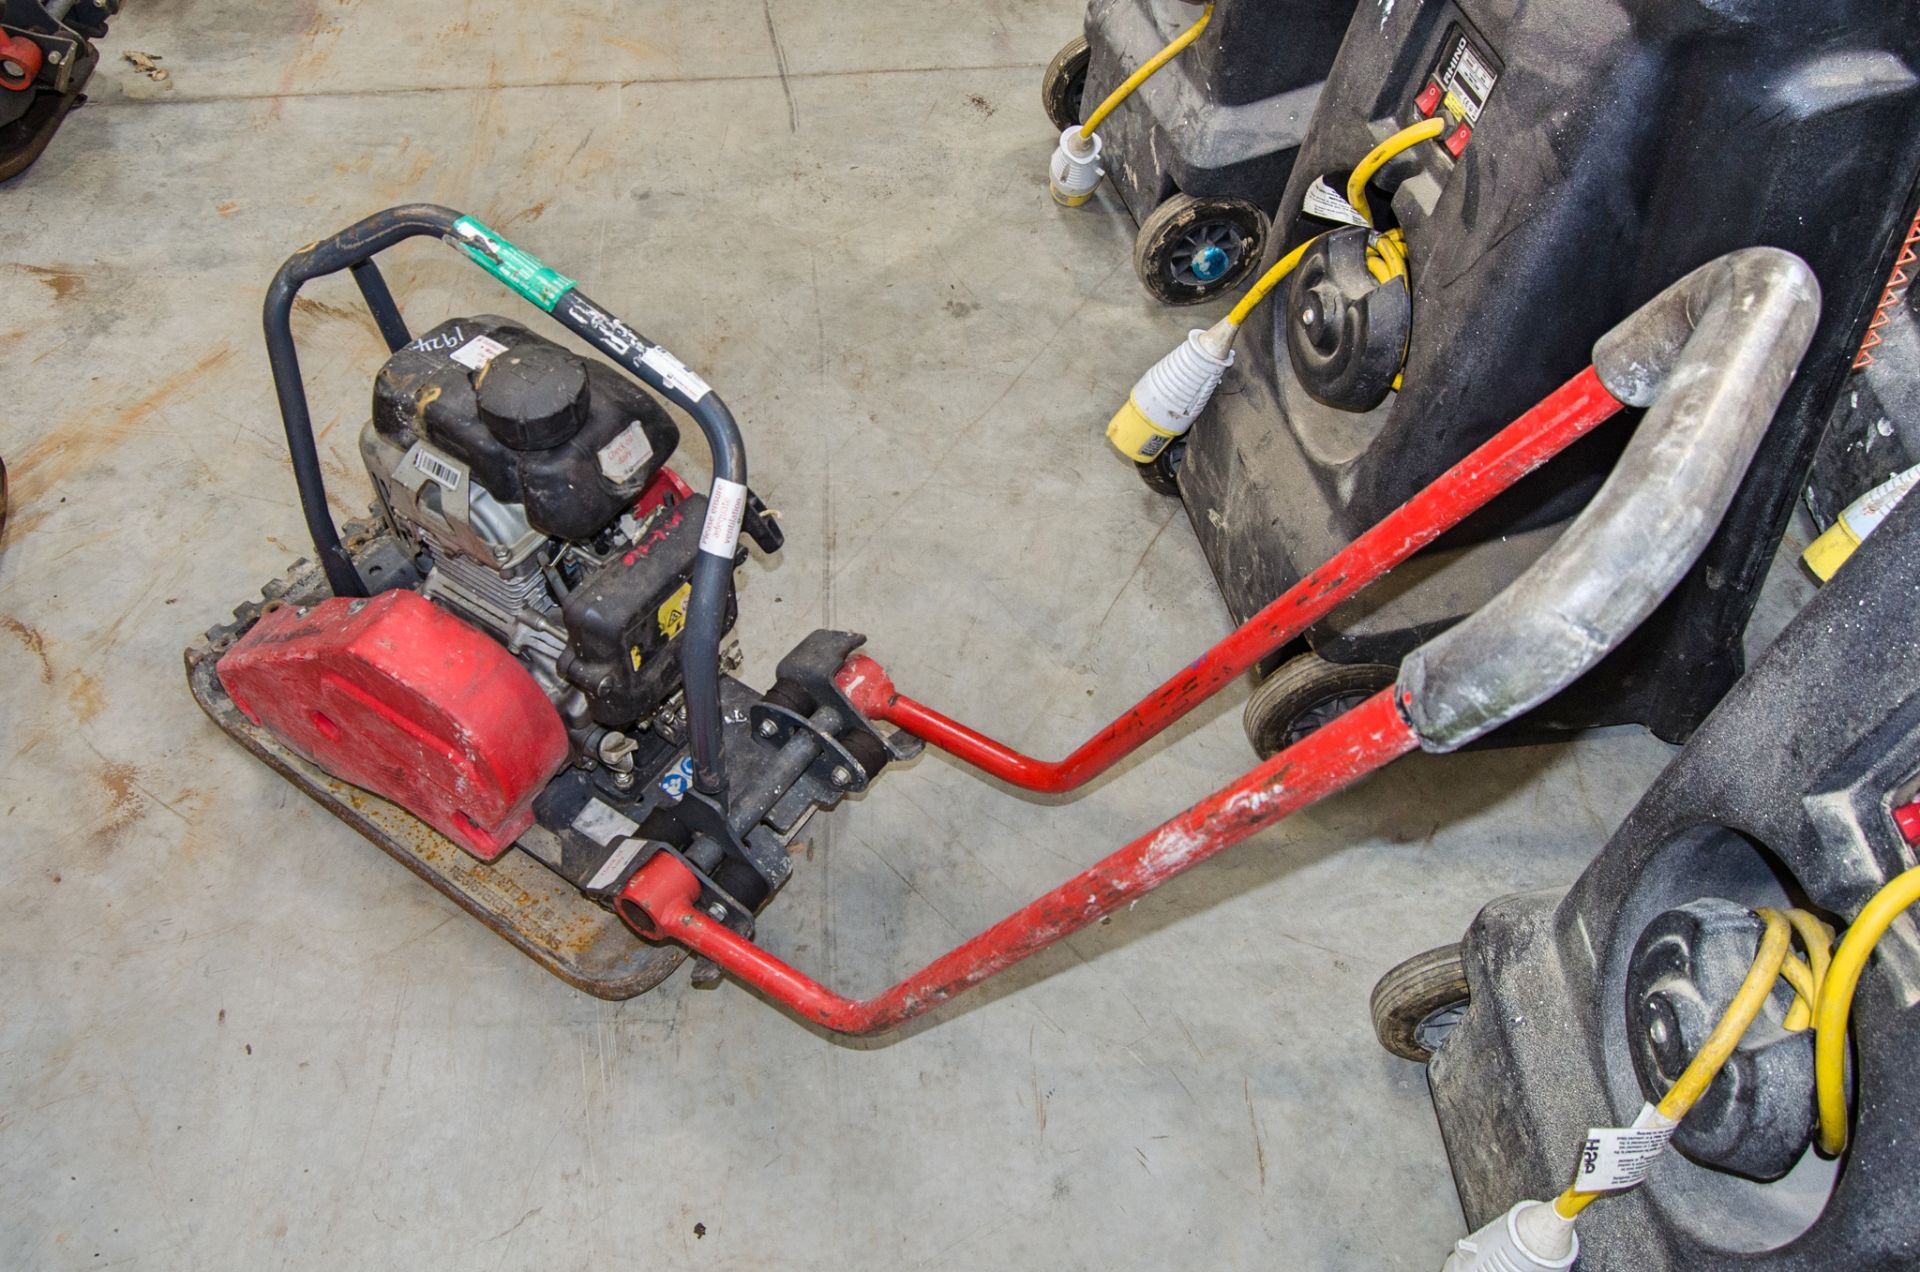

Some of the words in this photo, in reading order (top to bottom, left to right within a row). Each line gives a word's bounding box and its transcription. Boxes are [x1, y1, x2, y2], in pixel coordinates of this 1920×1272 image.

[1443, 37, 1467, 84] RHINO
[412, 326, 464, 352] 1924
[724, 498, 741, 544] ventilation
